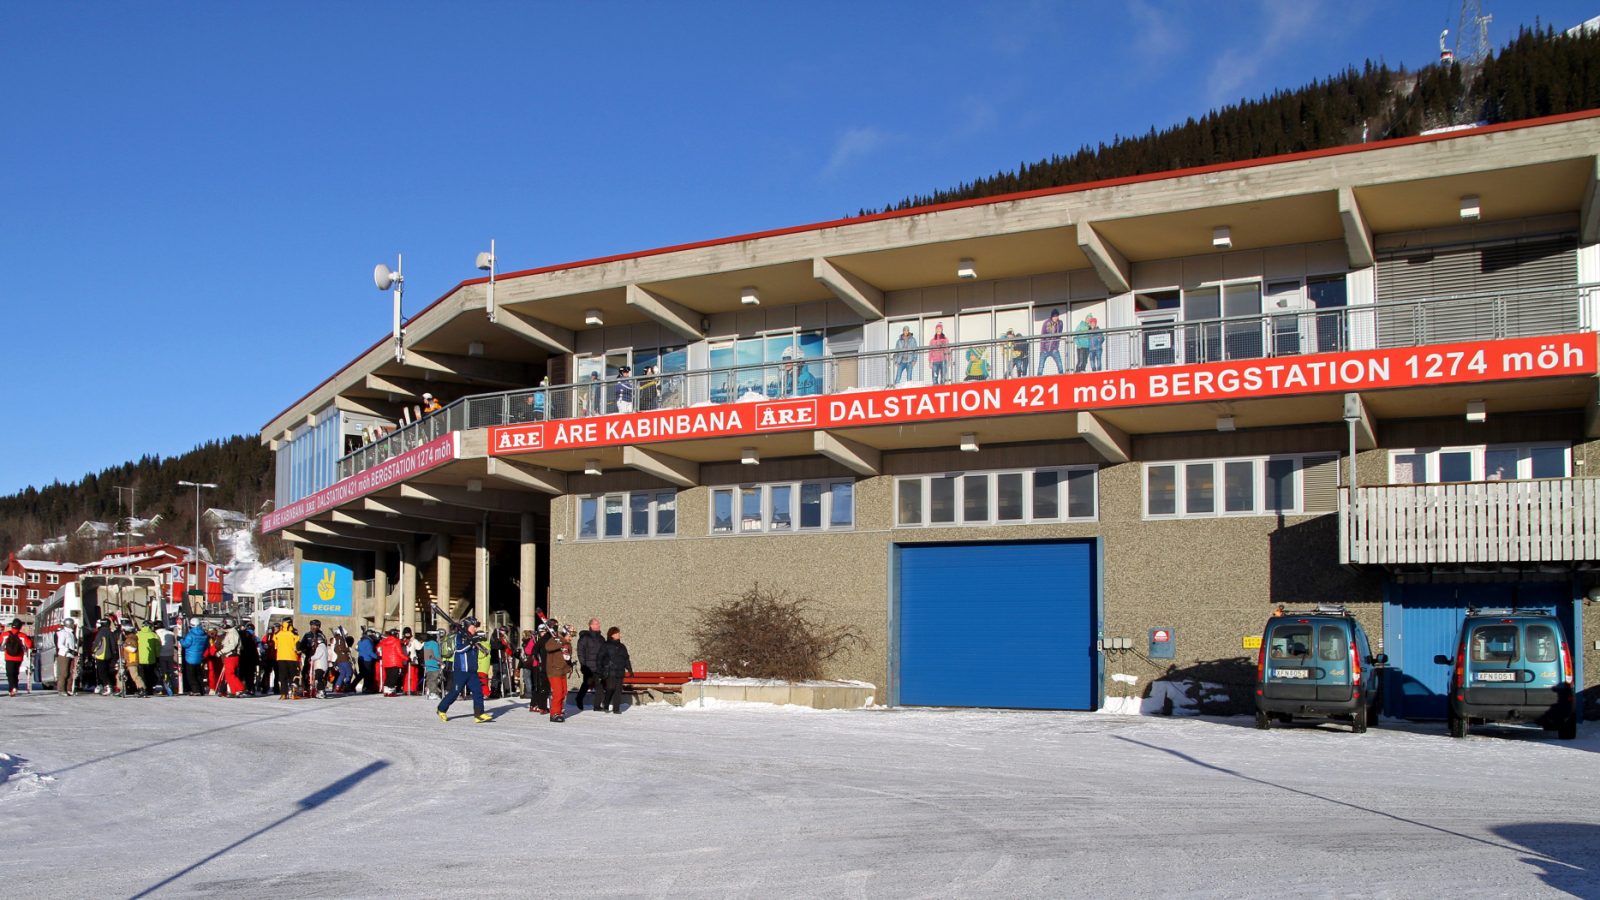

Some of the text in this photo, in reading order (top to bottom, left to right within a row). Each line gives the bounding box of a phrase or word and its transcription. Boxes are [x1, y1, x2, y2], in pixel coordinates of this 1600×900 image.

[498, 431, 540, 449] ÅRE
[554, 423, 597, 445] ÅRE
[605, 410, 743, 441] KABINBANA
[760, 407, 812, 426] ÅRE
[830, 388, 1001, 421] DALSTATION
[1012, 383, 1060, 407] 421
[1073, 378, 1136, 403] möh
[1149, 356, 1391, 398] BERGSTATION
[1405, 350, 1487, 379] 1274
[1503, 343, 1584, 372] möh
[317, 484, 348, 509] DALSTATION
[371, 453, 416, 486] BERGSTATION
[417, 447, 434, 467] 1274
[434, 442, 451, 460] möh
